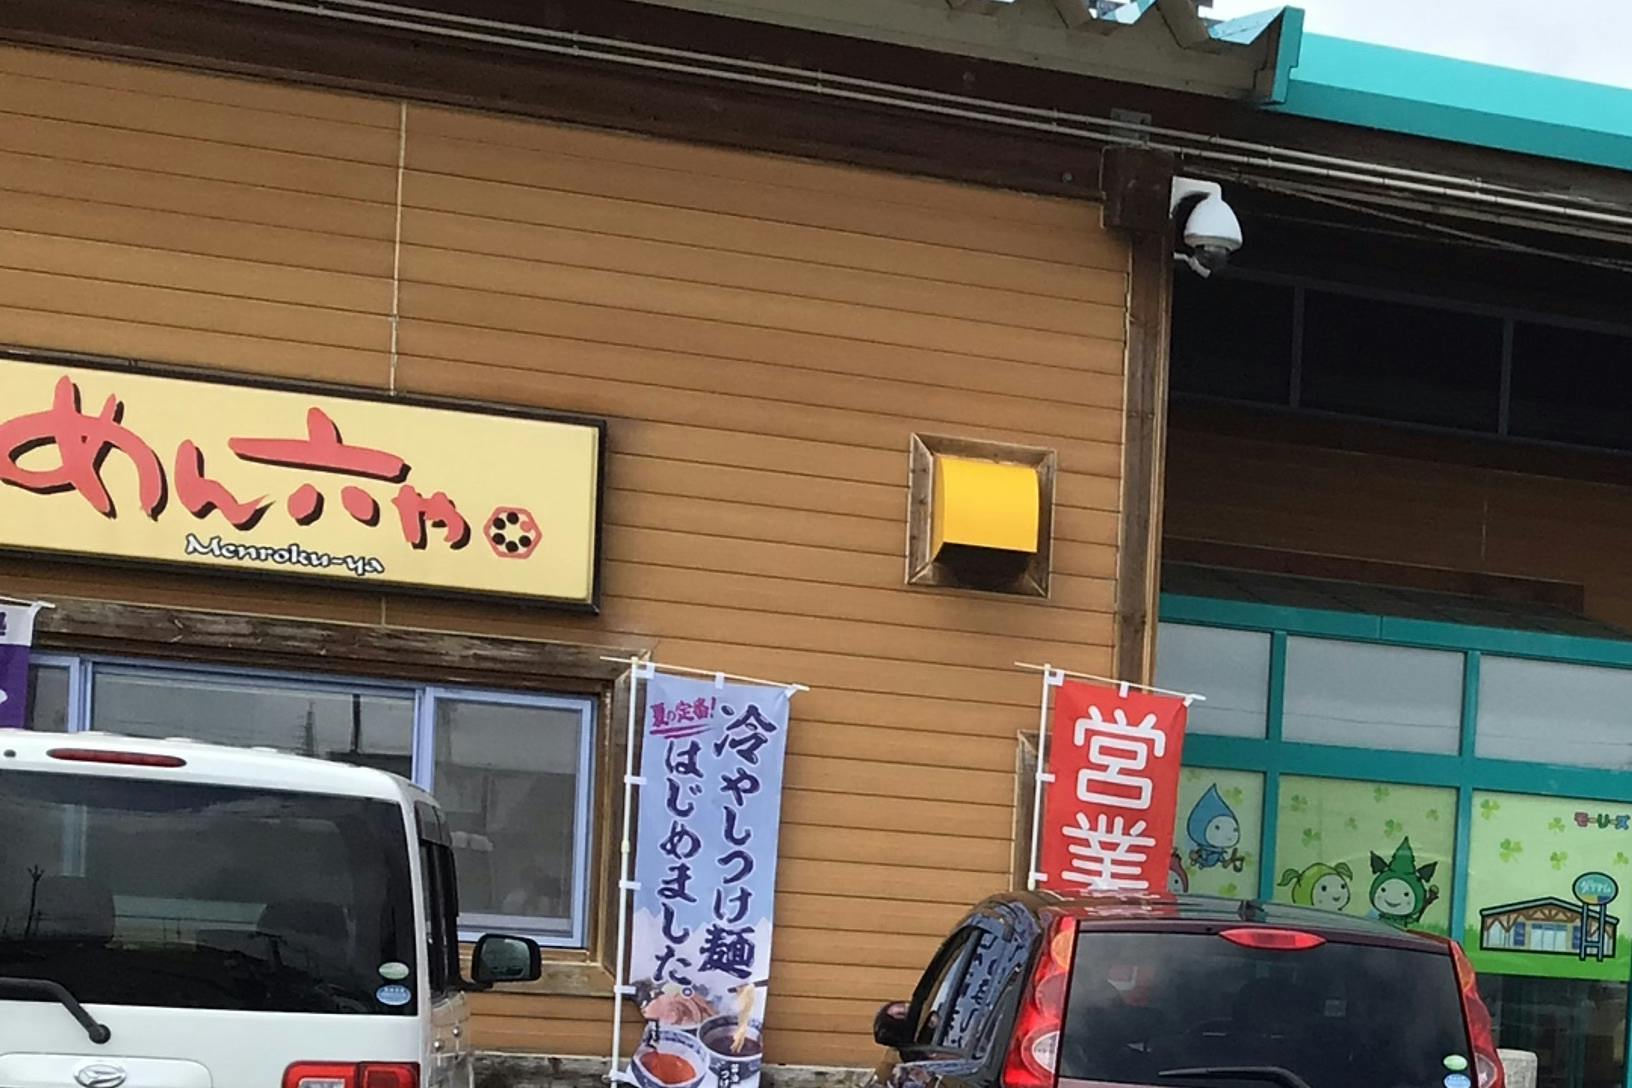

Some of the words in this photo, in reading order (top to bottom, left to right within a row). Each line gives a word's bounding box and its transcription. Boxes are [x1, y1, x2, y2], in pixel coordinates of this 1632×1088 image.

[184, 532, 386, 577] Menroku-ya
[697, 703, 777, 980] 冷やしつけ麺
[1060, 704, 1167, 890] 営業
